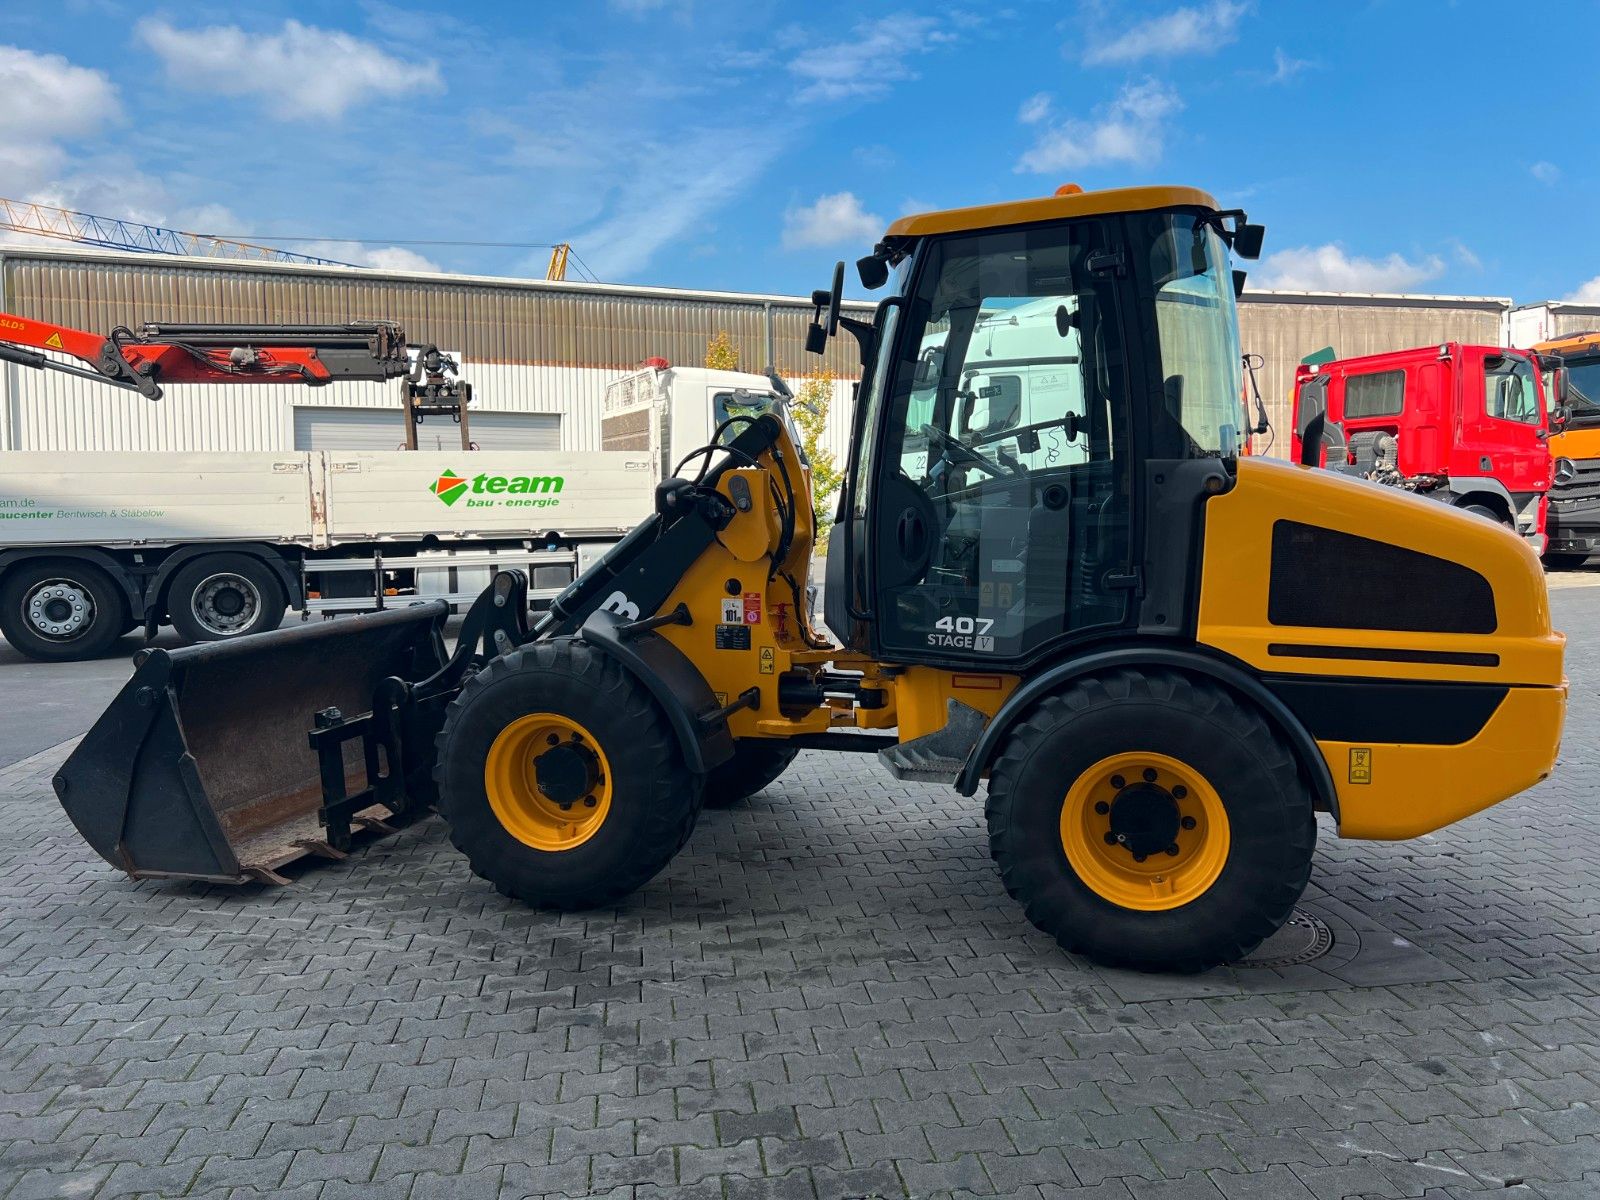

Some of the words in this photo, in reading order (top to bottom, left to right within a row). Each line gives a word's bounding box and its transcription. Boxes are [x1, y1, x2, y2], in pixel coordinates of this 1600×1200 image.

[471, 472, 565, 494] team
[466, 499, 494, 507] bau
[505, 497, 560, 508] energie
[0, 511, 53, 519] aucenter
[56, 510, 107, 519] Bentwisch
[110, 510, 117, 518] &
[725, 609, 737, 622] 101
[935, 616, 994, 635] 407
[927, 633, 973, 648] STAGE
